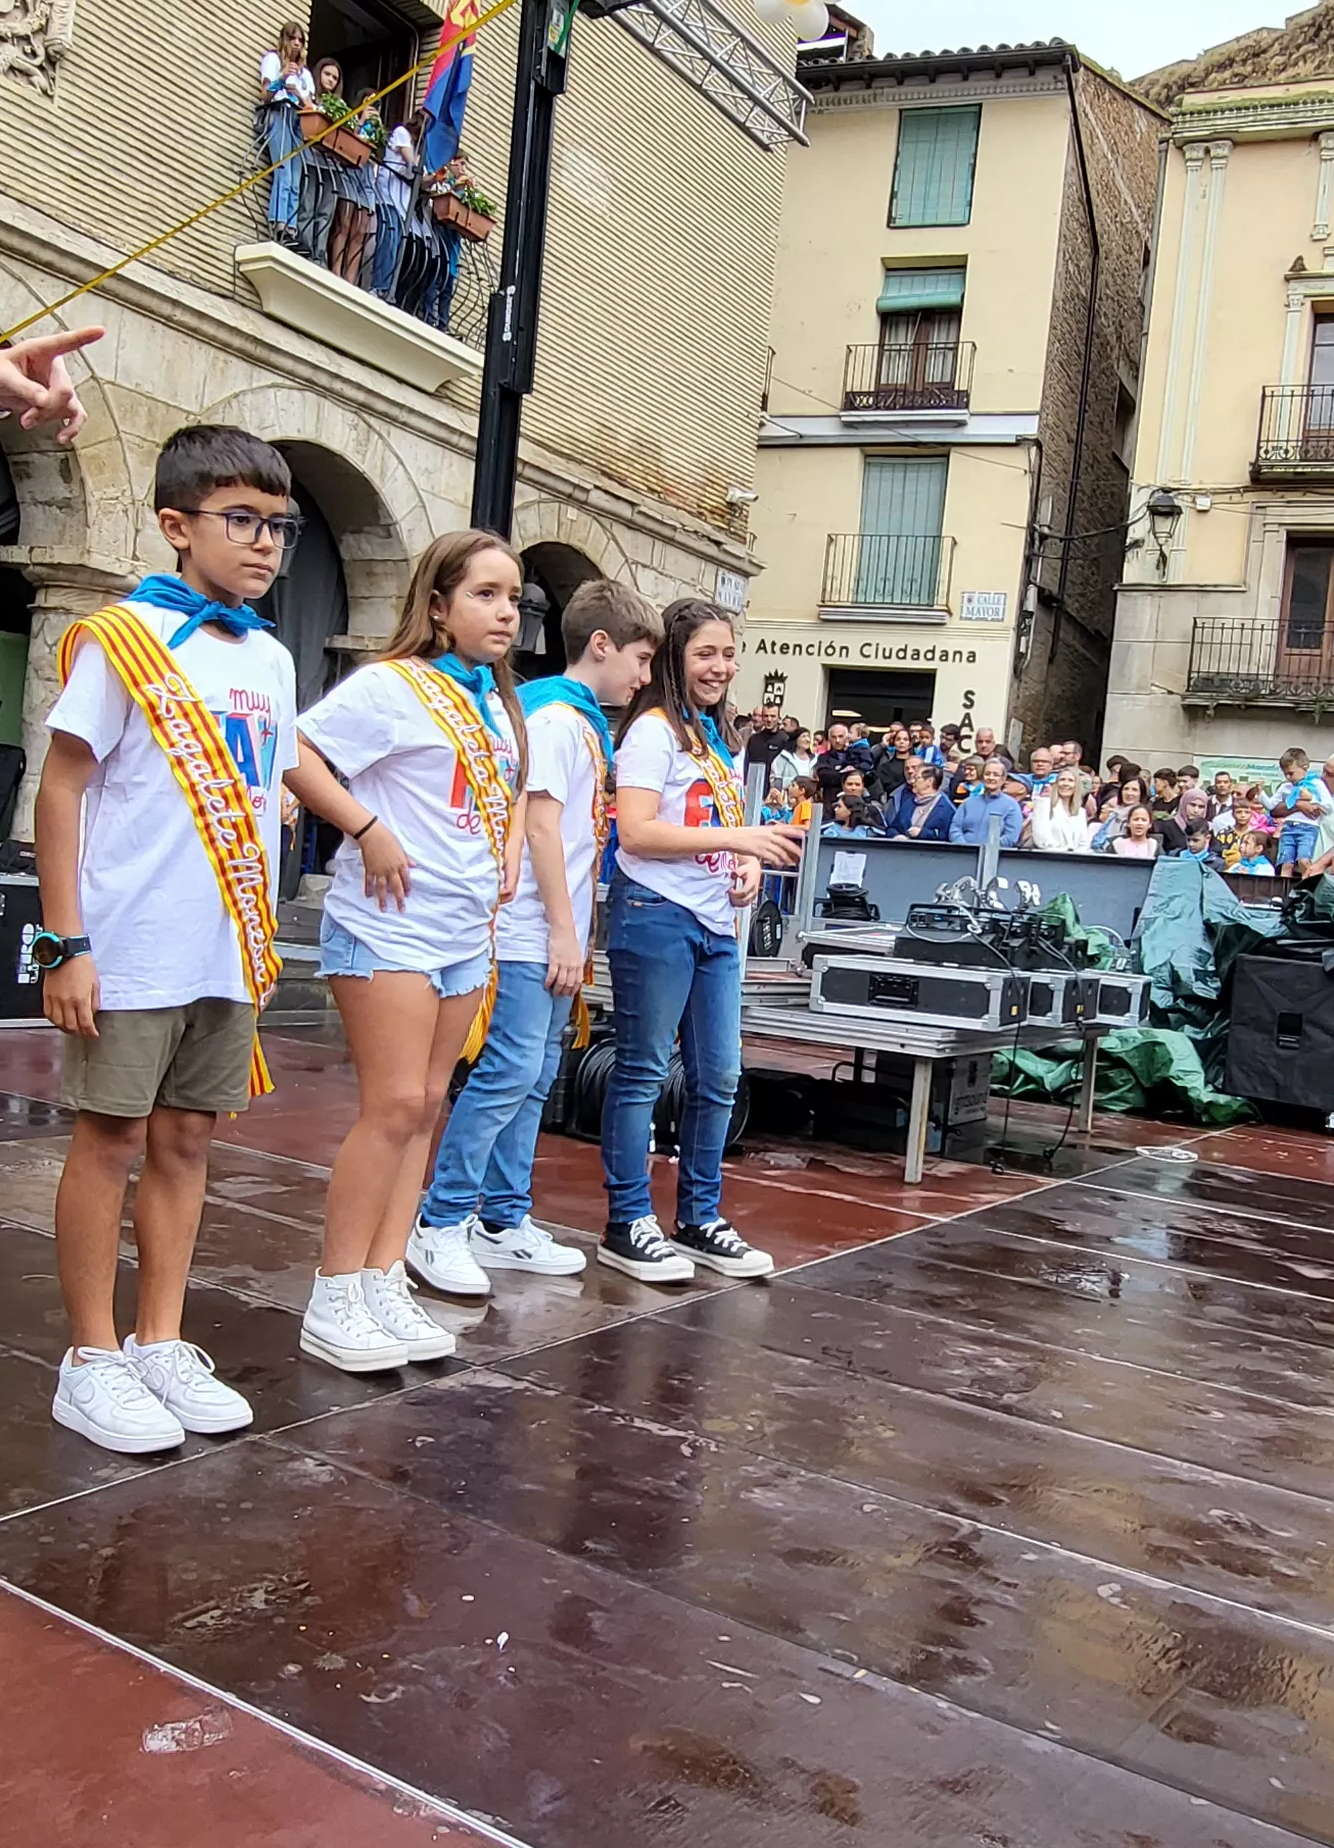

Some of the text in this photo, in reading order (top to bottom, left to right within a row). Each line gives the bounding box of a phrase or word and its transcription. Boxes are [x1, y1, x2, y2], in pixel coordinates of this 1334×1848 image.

[977, 595, 1002, 605] CALLE
[966, 606, 1000, 617] MAYOR
[755, 638, 977, 663] Atención Ciudadana
